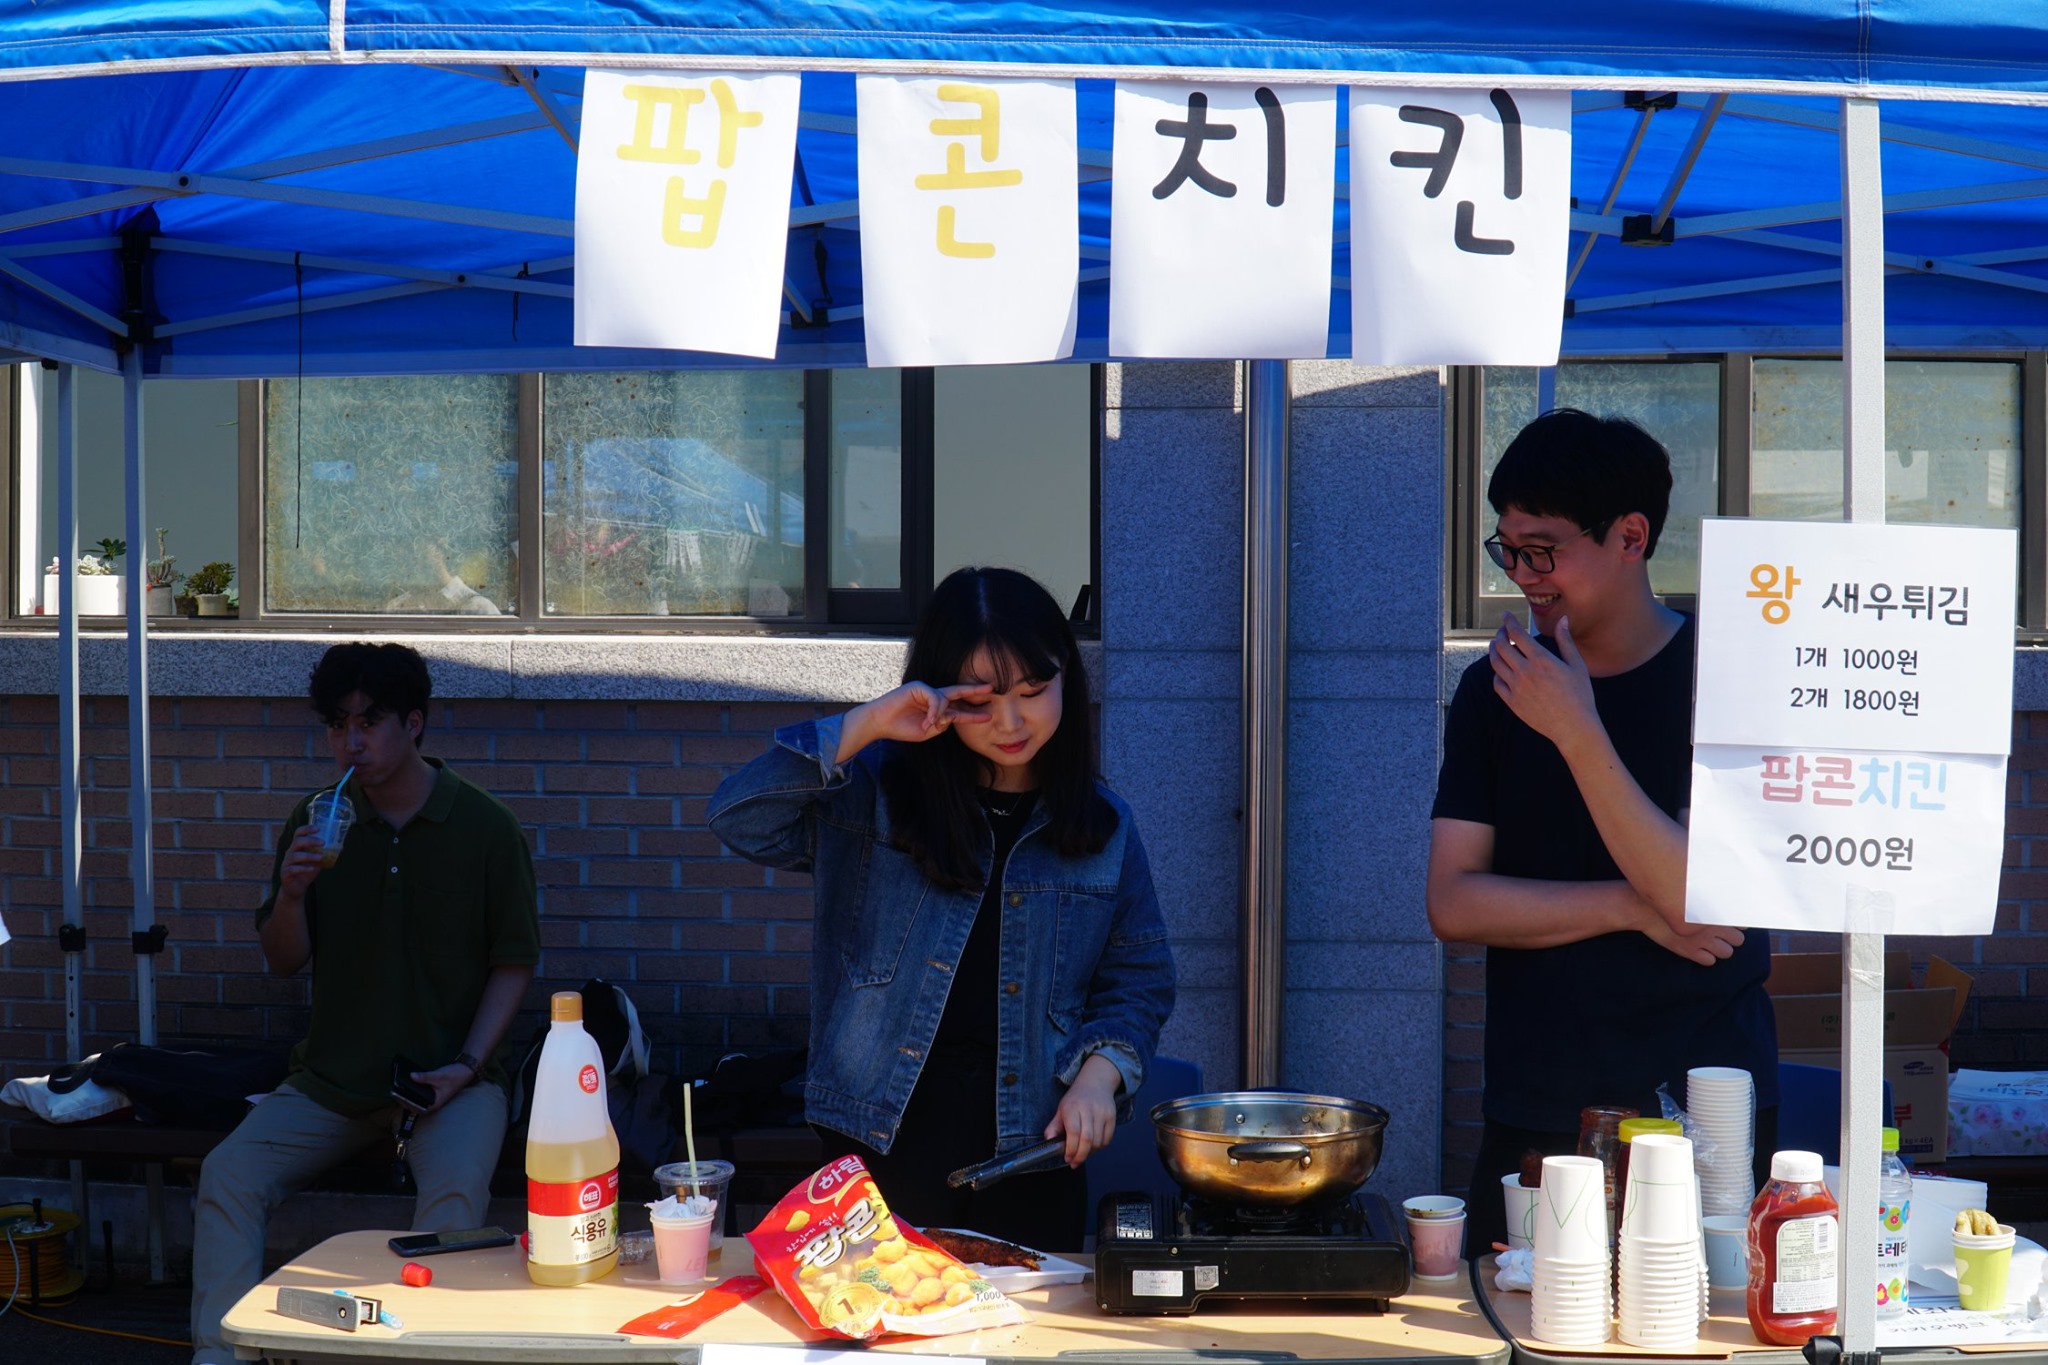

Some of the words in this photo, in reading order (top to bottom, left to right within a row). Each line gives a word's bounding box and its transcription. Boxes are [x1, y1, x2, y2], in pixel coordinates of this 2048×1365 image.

[617, 78, 764, 249] 팝
[914, 83, 1024, 259] 콘
[1151, 86, 1286, 208] 치
[1388, 87, 1524, 256] 킨
[1746, 563, 1802, 625] 왕
[1821, 582, 1969, 626] 새우튀김
[1795, 647, 1827, 668] 1개
[1843, 648, 1918, 676] 1000원
[1790, 687, 1828, 709] 2개
[1844, 689, 1920, 717] 1800원
[1760, 755, 1947, 811] 팝콘치킨
[1786, 833, 1914, 871] 2000원
[819, 1154, 865, 1189] 하림
[571, 1218, 607, 1243] 식용유
[795, 1198, 880, 1267] 팝콘
